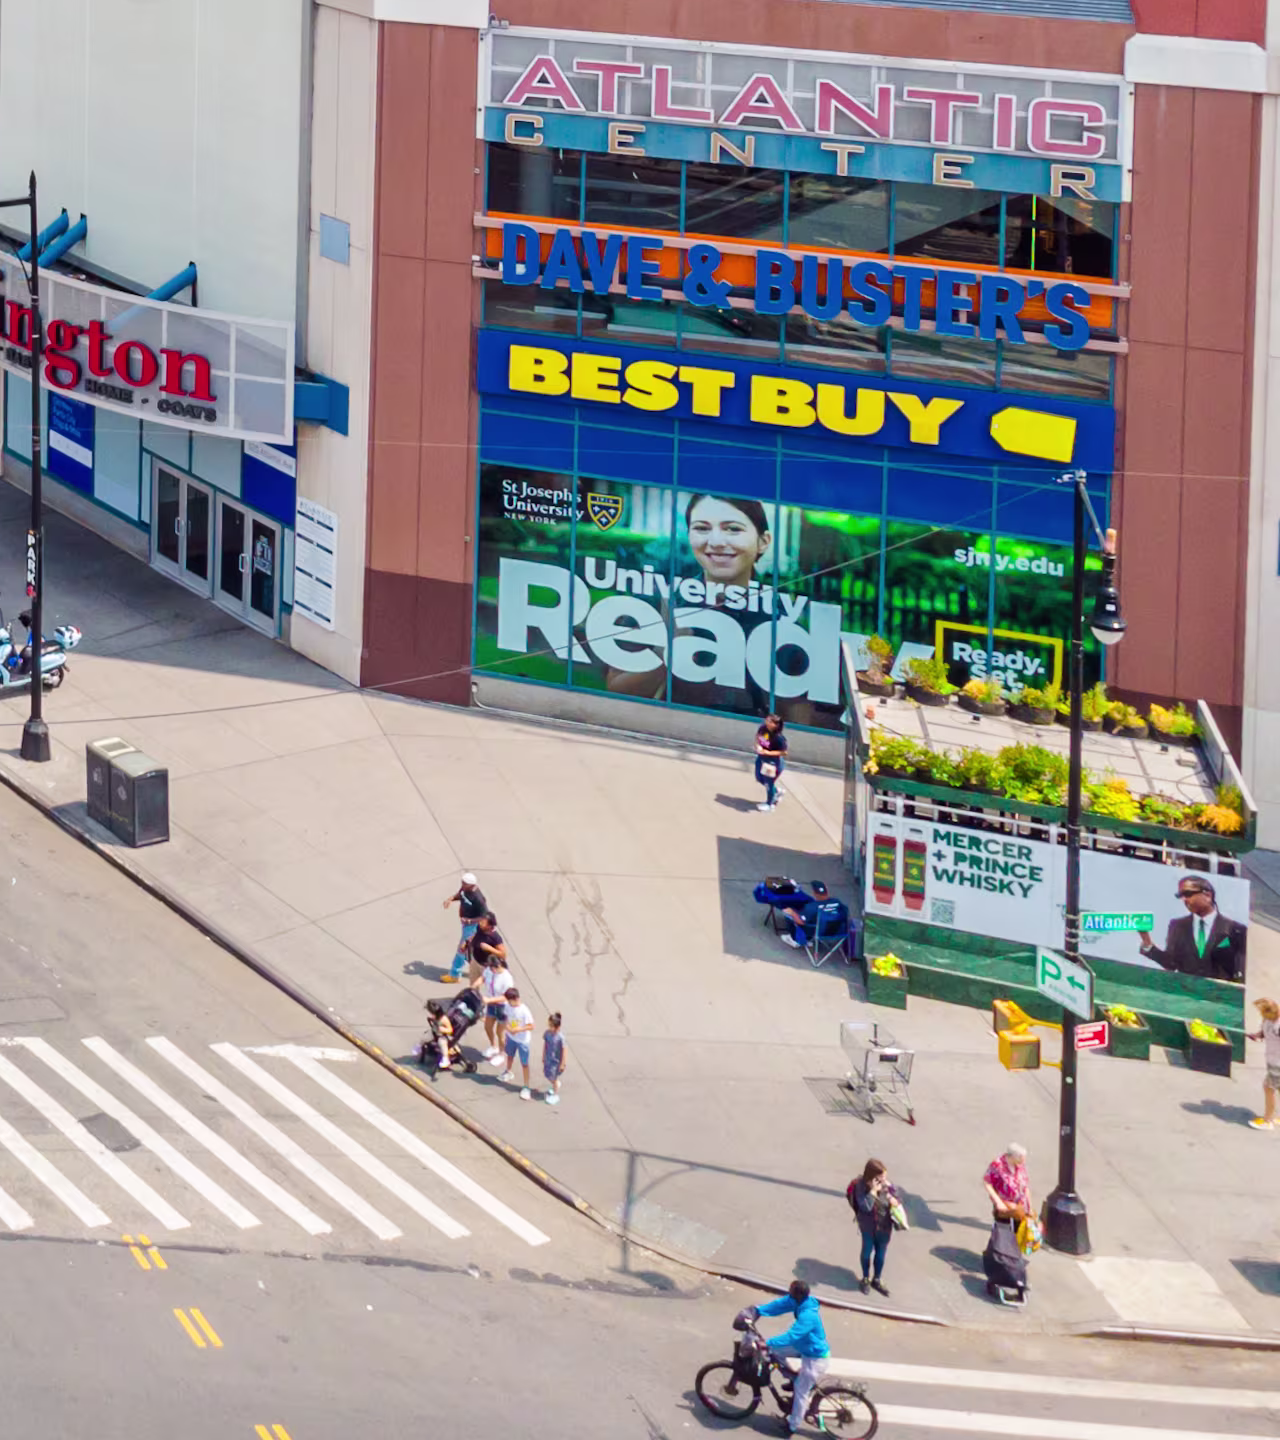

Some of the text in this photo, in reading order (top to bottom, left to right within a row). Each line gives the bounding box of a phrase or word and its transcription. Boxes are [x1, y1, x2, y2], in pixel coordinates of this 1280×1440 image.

[503, 54, 1107, 158] ATLANTIC
[504, 113, 1097, 200] CENTER
[502, 221, 1092, 351] DAVE & BUSTER'S
[85, 379, 134, 404] HOME
[157, 399, 217, 422] COATS
[508, 344, 965, 446] BEST BUY
[503, 494, 584, 521] University
[520, 481, 582, 504] Josephs
[504, 512, 557, 526] NEW YORK
[27, 534, 37, 586] PARK
[954, 546, 1064, 577] sjny.edu
[584, 557, 809, 623] University
[952, 641, 1045, 676] Ready.
[932, 828, 1032, 862] MERCER
[932, 866, 1033, 899] WHISKY
[954, 851, 1043, 882] PRINCE
[1085, 915, 1138, 929] Atlantic
[1042, 955, 1062, 985] P
